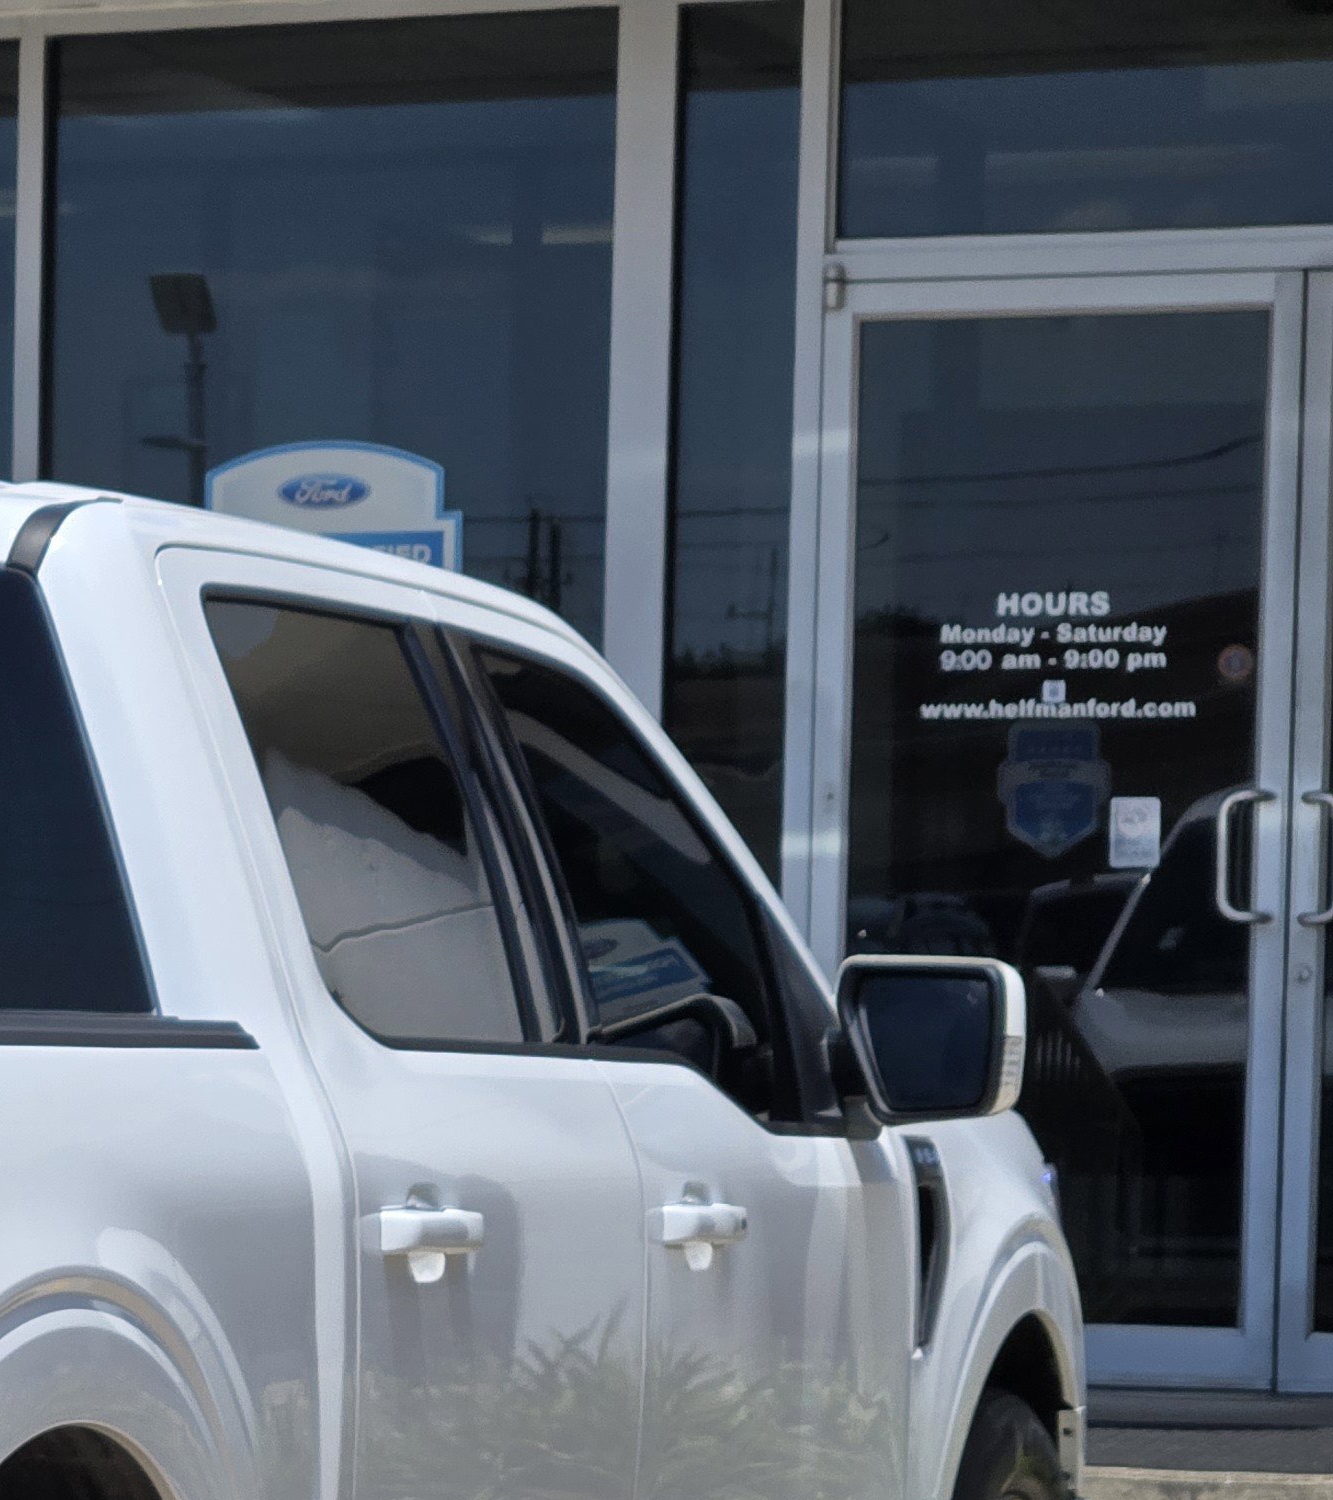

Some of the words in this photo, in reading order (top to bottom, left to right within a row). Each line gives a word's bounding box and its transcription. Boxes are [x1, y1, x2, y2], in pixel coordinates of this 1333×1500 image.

[294, 479, 352, 503] Ford
[997, 591, 1110, 616] HOURS
[940, 623, 1034, 647] Monday
[1057, 621, 1167, 646] Saturday
[940, 649, 992, 671] 9:00
[1002, 653, 1041, 669] am
[1064, 648, 1119, 669] 9:00
[1126, 652, 1167, 672] pm
[920, 698, 1196, 718] www.helfmanford.com
